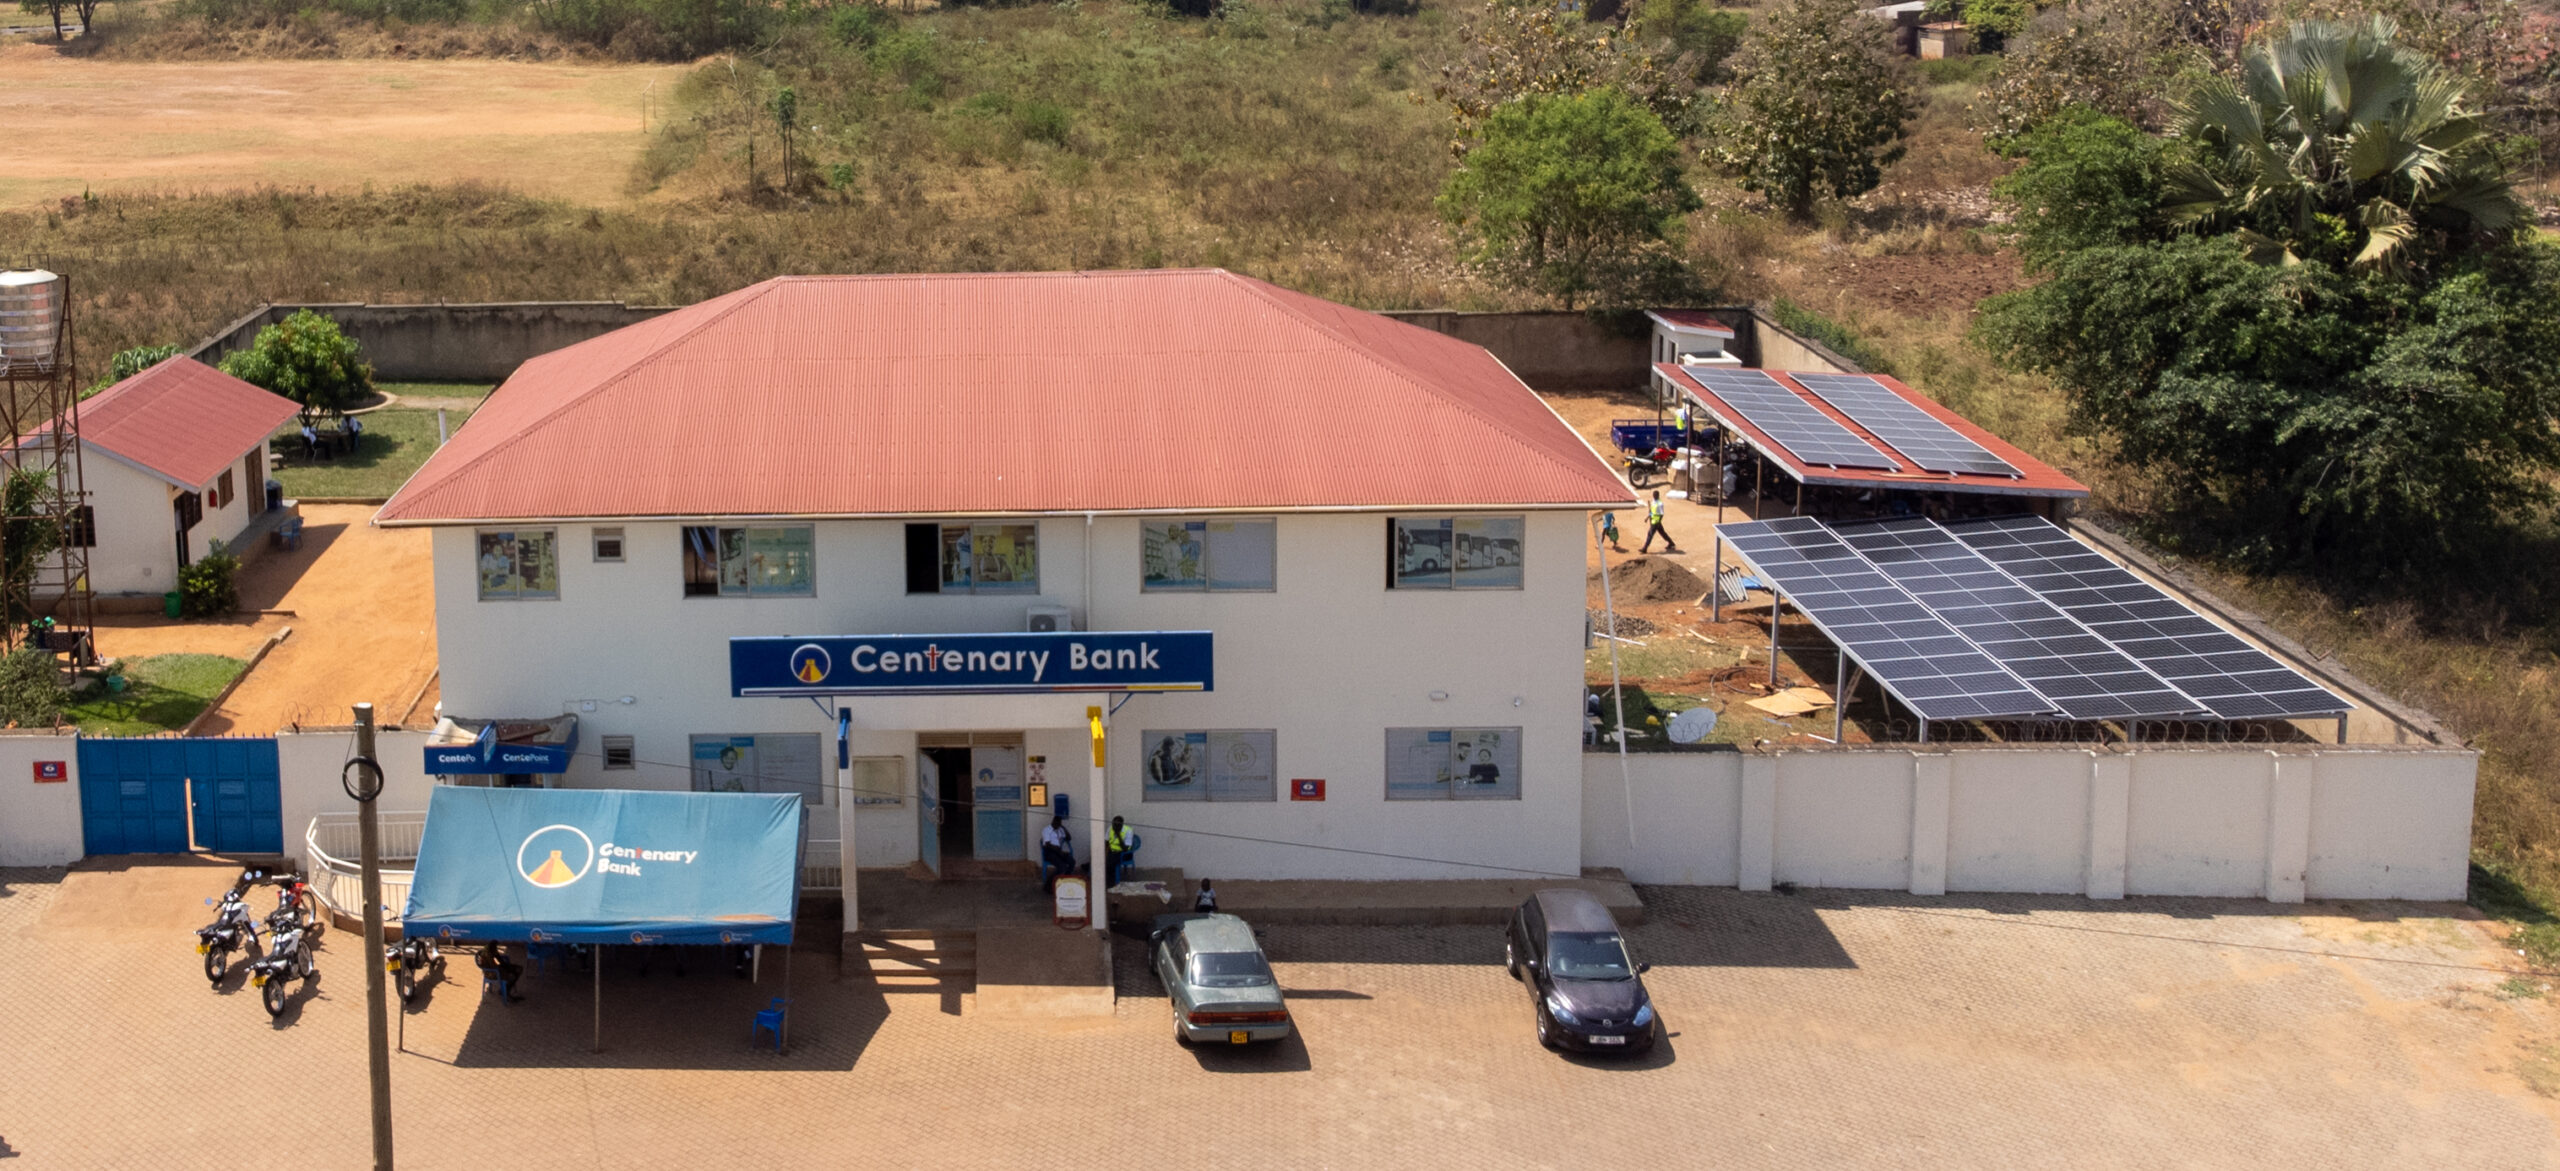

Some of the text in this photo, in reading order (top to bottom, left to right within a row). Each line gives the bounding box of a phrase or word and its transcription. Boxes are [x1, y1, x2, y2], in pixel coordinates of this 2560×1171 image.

[851, 642, 1160, 682] Centenary Bank
[502, 753, 550, 763] CentePoint
[599, 842, 698, 864] Centenary
[597, 857, 642, 876] Bank
